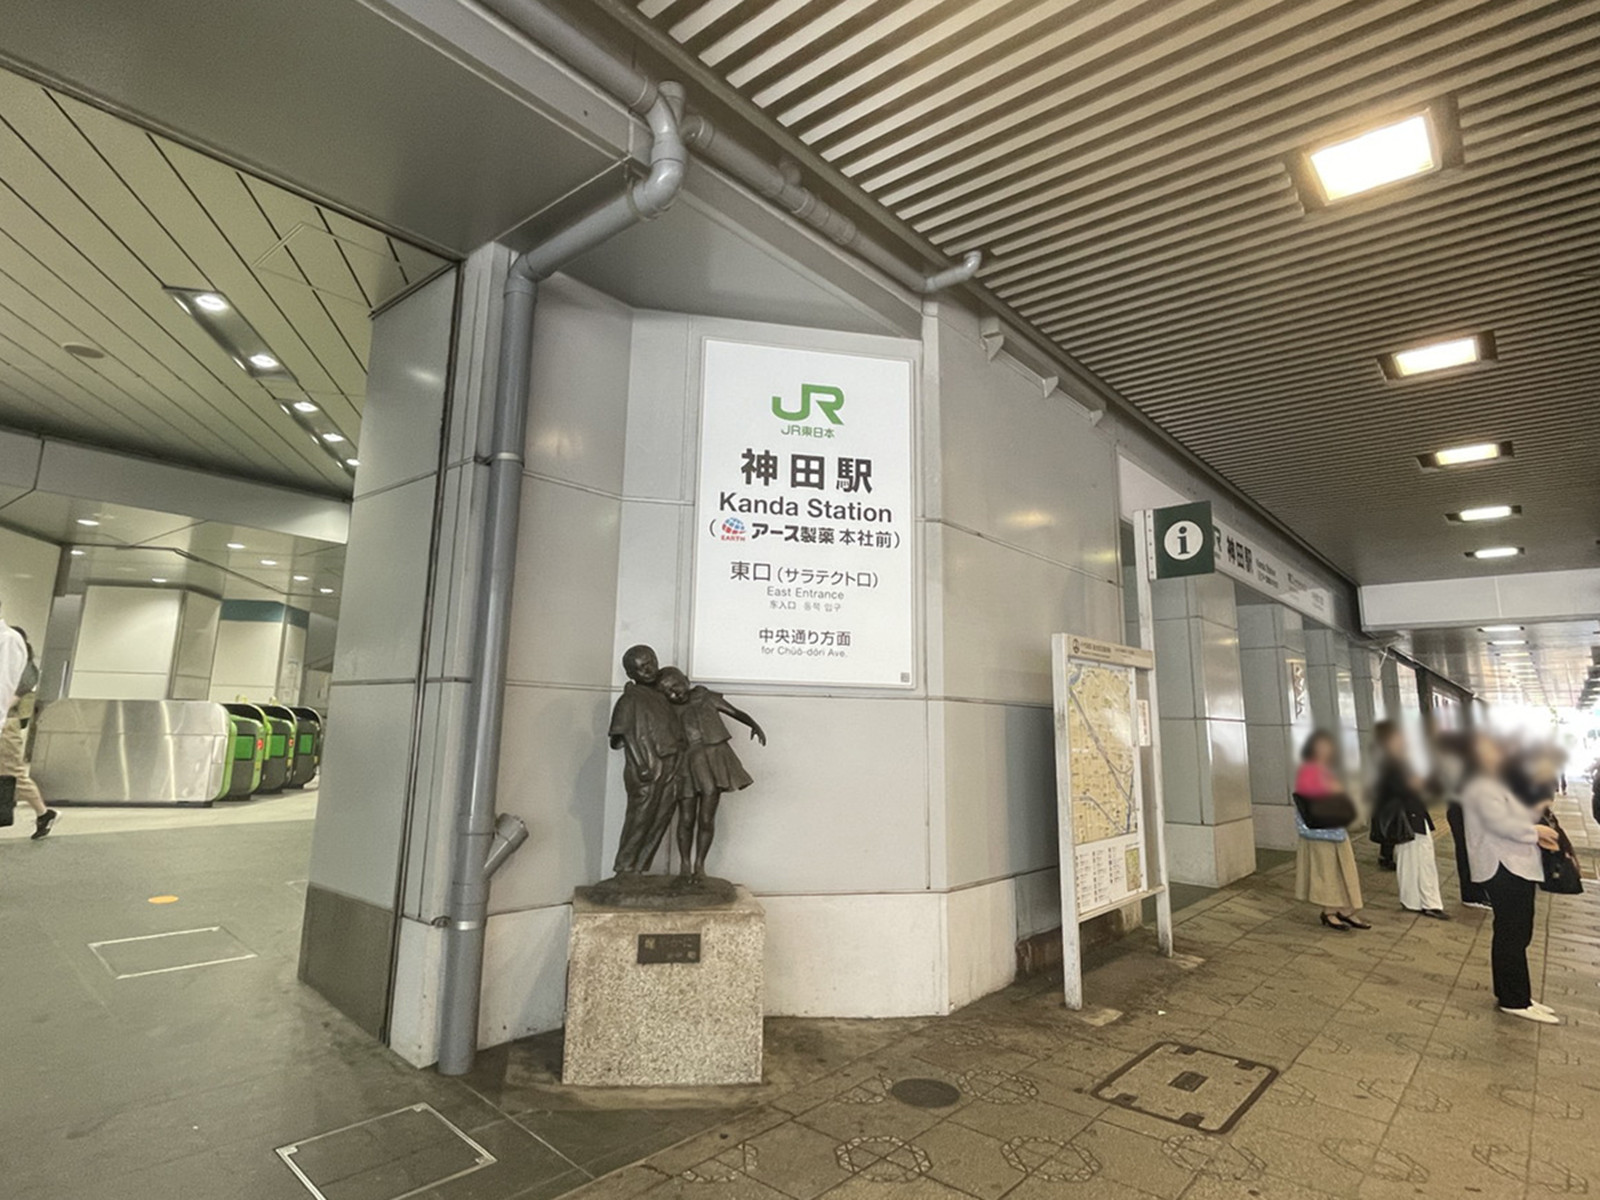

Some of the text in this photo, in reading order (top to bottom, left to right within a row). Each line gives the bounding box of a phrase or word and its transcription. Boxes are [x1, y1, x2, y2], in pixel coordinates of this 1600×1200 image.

[771, 383, 845, 426] JR
[780, 424, 836, 438] JR東日本
[740, 447, 873, 494] 神田駅
[719, 491, 892, 523] Kanda Station
[766, 586, 845, 600] East Entrance
[759, 627, 851, 647] 中央通り方面
[761, 646, 775, 655] for
